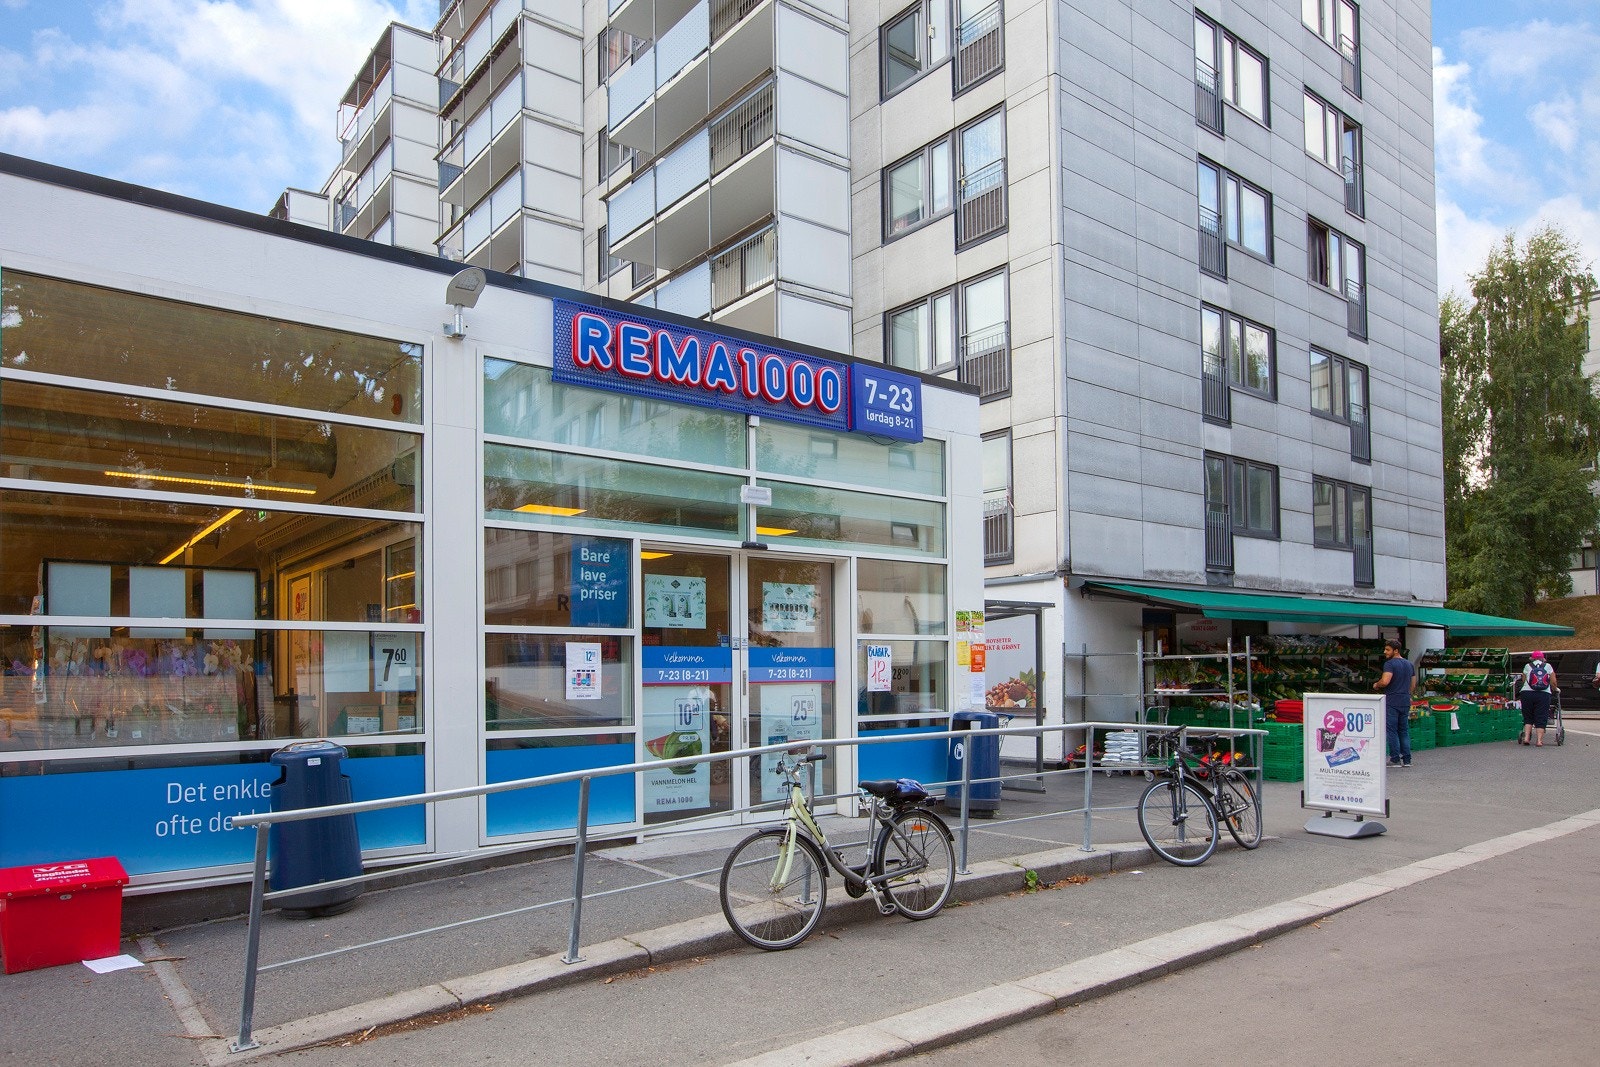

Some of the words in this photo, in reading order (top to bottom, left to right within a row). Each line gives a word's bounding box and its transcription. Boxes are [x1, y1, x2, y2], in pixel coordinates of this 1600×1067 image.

[865, 378, 913, 412] 7-23
[866, 409, 893, 427] lørdag
[895, 416, 914, 428] 8-21
[580, 547, 610, 563] Bare
[580, 567, 606, 582] lave
[580, 586, 617, 602] priser
[663, 651, 704, 663] Velkommen
[771, 651, 807, 663] Velkommen
[658, 670, 680, 681] 7-23
[682, 669, 709, 681] (8-21)
[768, 669, 787, 679] 7-23
[788, 668, 812, 679] (8-21)
[1326, 715, 1336, 728] 2
[1319, 768, 1351, 776] MULTIPACK
[651, 778, 686, 786] VANNMELON
[167, 782, 206, 804] Det
[213, 778, 271, 800] enkle
[656, 797, 677, 805] REMA
[1324, 794, 1345, 802] REMA
[155, 814, 202, 837] ofte
